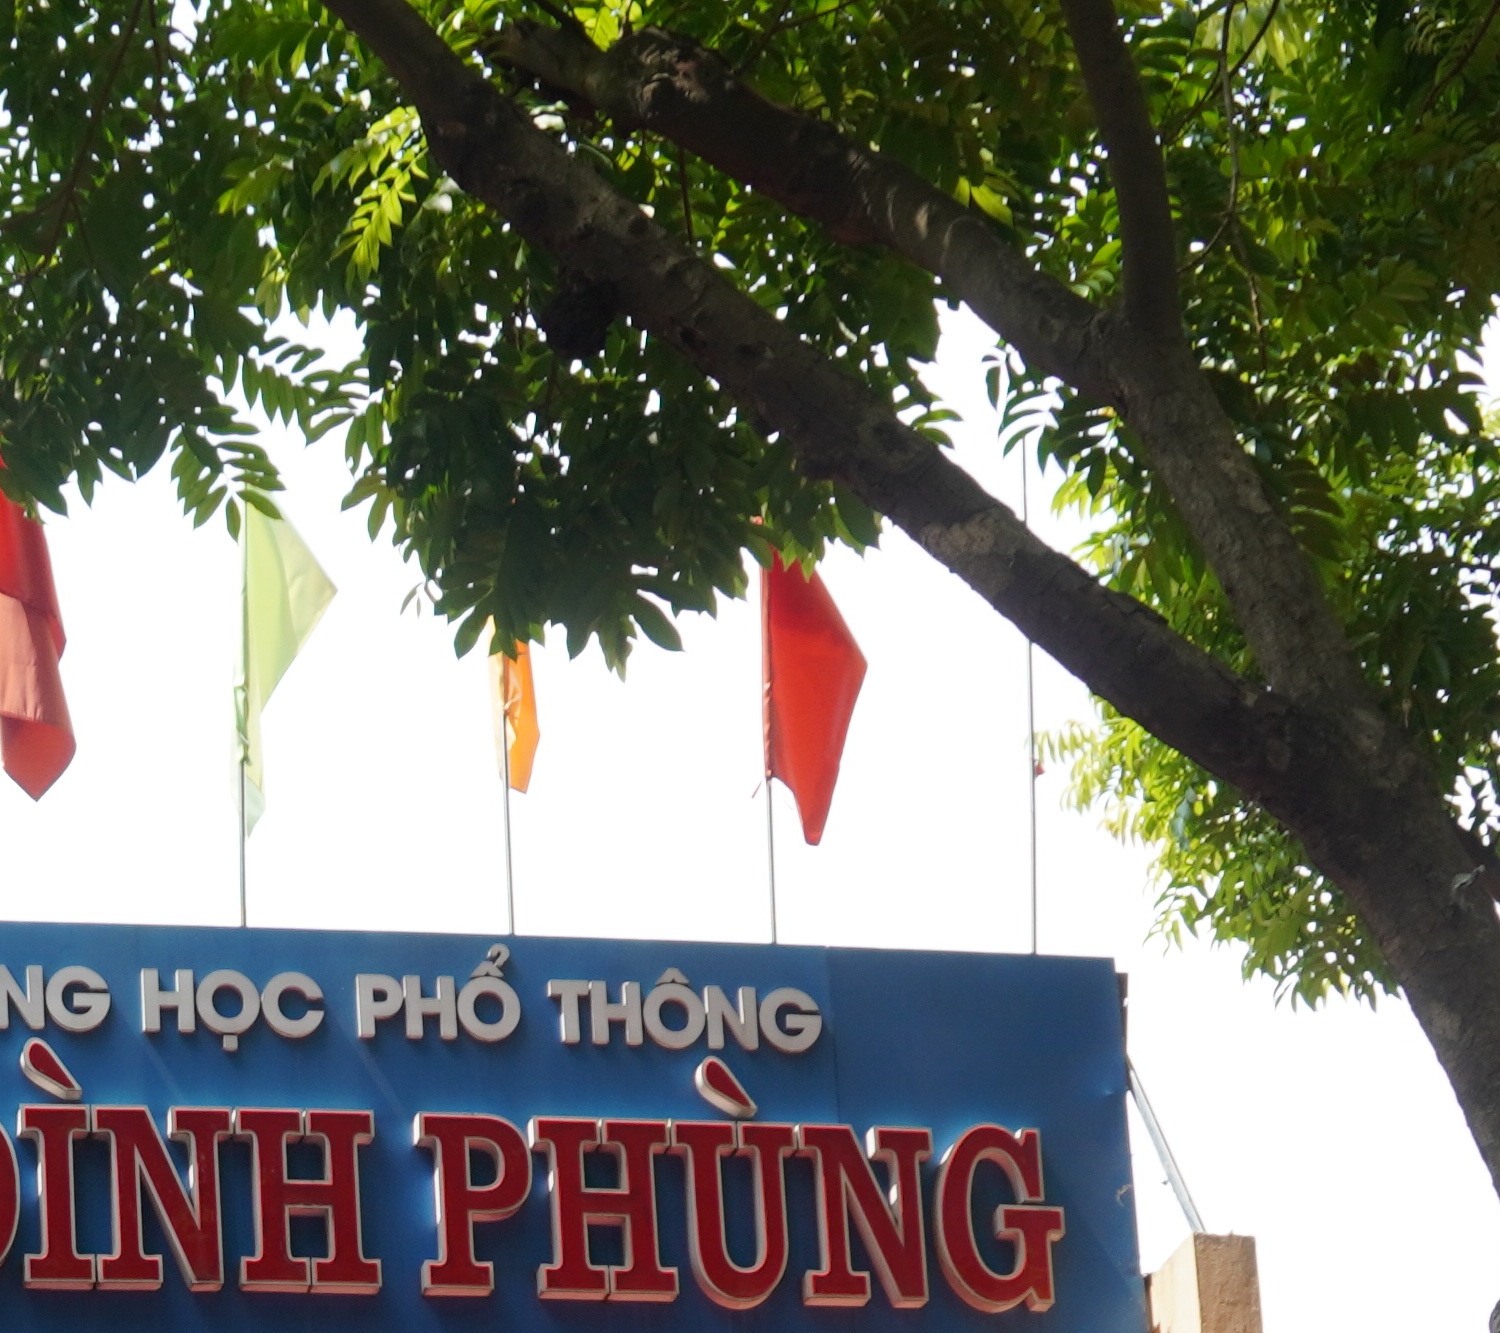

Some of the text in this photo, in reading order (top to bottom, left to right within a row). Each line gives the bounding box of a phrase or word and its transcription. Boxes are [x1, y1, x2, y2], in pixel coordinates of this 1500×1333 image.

[141, 968, 325, 1053] HỌC
[356, 943, 521, 1044] PHỔ
[547, 968, 823, 1055] THÔNG
[413, 1055, 1066, 1314] PHÙNG
